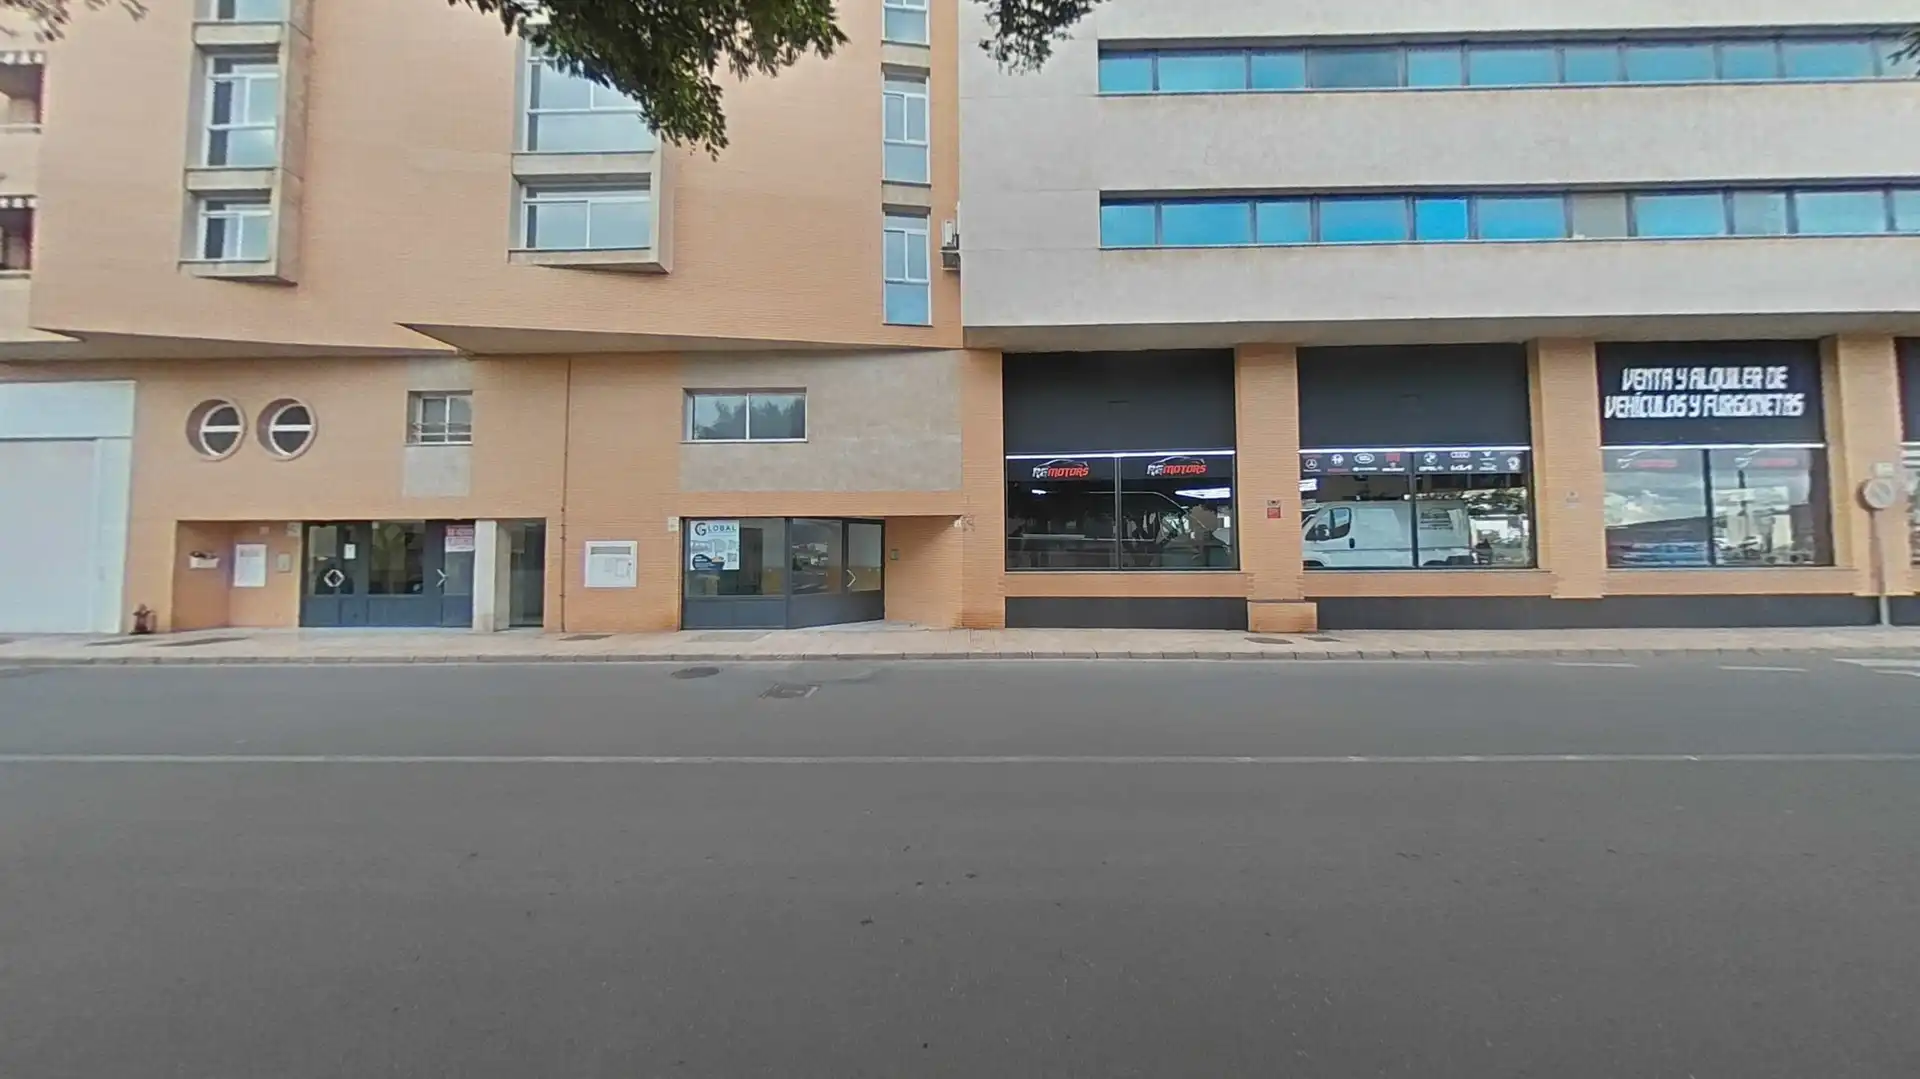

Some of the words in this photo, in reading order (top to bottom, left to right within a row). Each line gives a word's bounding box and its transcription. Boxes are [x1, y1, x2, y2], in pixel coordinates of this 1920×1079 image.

[1621, 367, 1675, 391] VENTA
[1675, 367, 1688, 391] Y
[1689, 366, 1763, 393] ALQUILER
[1765, 365, 1789, 390] DE
[1603, 391, 1687, 419] VEHÍCULOS
[1688, 394, 1701, 418] Y
[1702, 392, 1806, 418] FURGONETAS
[694, 522, 737, 536] GLOBAL
